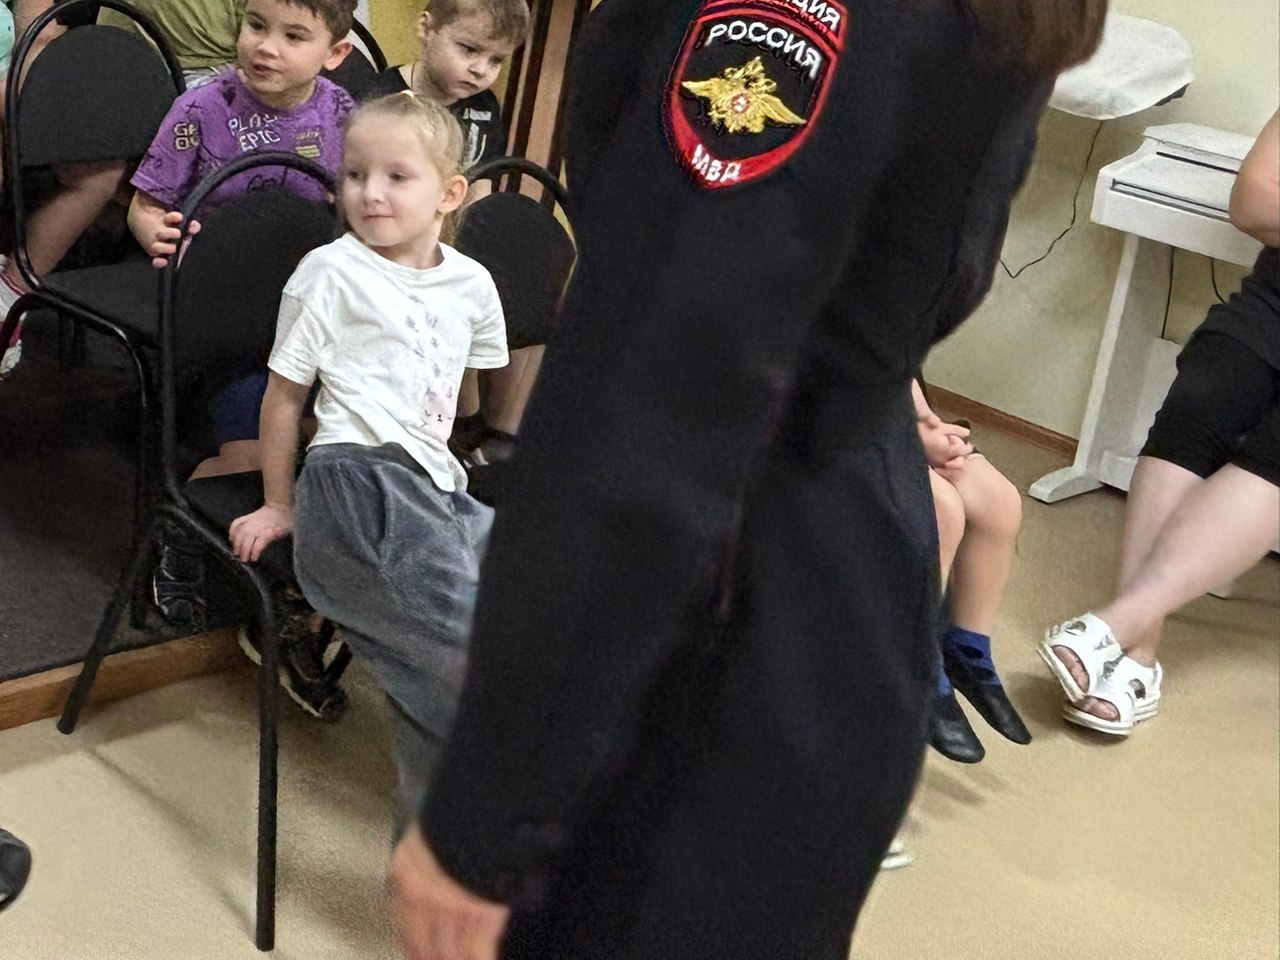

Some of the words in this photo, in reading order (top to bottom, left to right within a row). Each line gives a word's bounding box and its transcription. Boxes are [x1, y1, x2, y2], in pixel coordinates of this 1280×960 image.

[704, 20, 823, 81] РОССИЯ
[238, 129, 281, 153] EPIC
[691, 143, 742, 183] МВД
